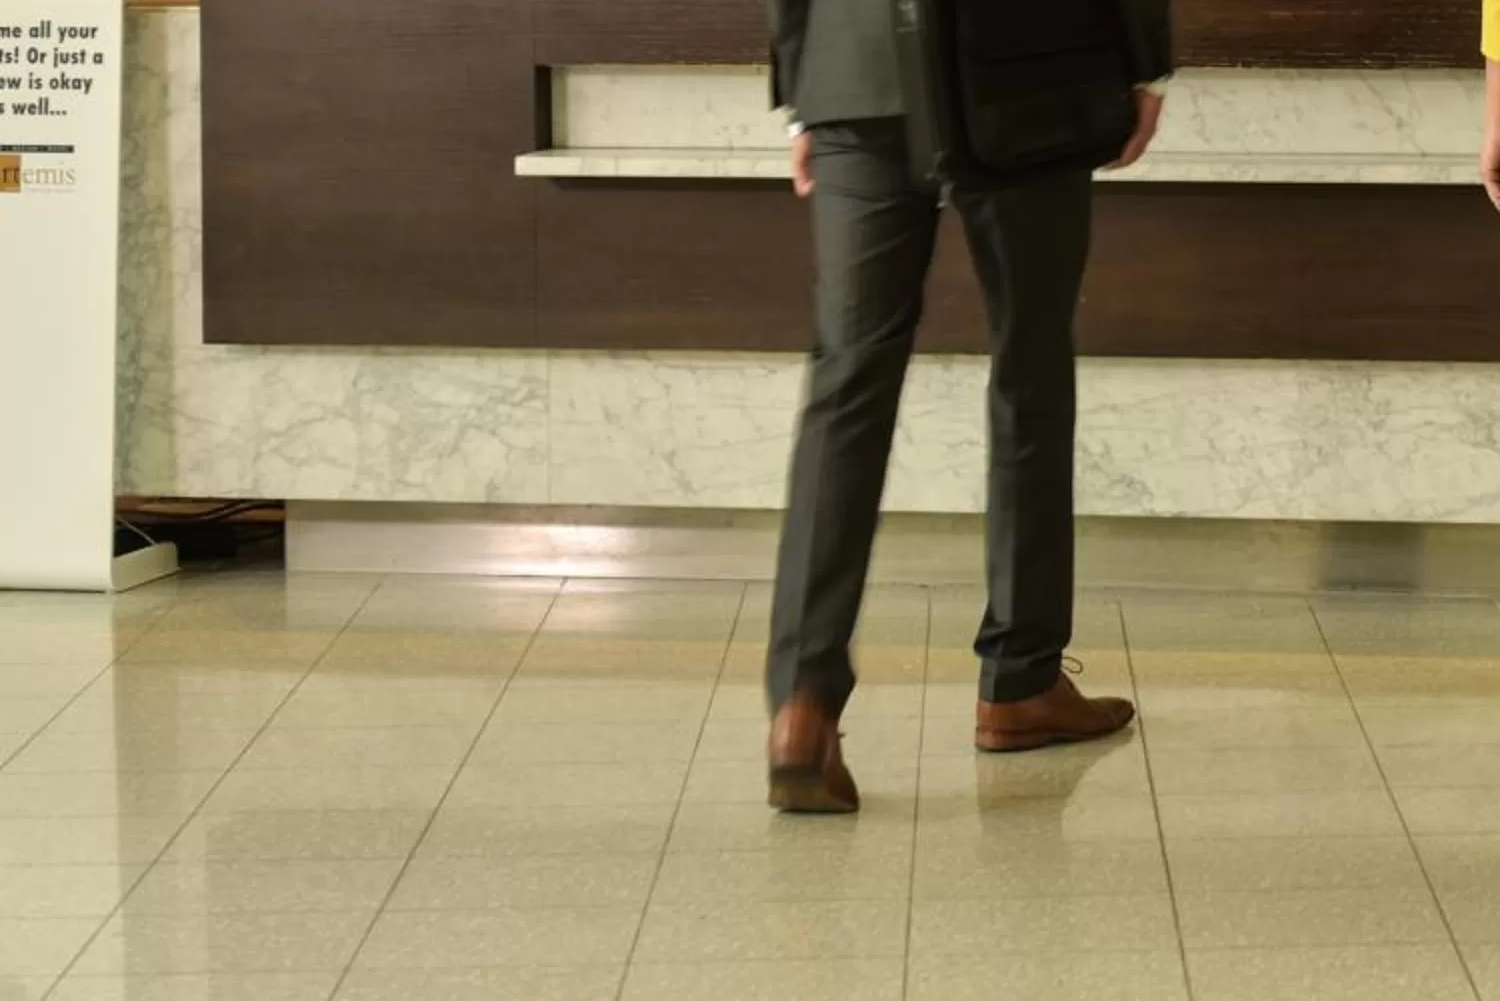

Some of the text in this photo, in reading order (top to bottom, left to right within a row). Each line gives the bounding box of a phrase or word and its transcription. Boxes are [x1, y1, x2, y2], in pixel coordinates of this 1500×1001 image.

[29, 19, 51, 39] all
[58, 26, 99, 44] your
[27, 47, 47, 65] Or
[53, 47, 86, 69] just
[93, 52, 104, 65] a
[28, 72, 43, 90] is
[49, 71, 93, 95] okay
[12, 96, 68, 116] well...
